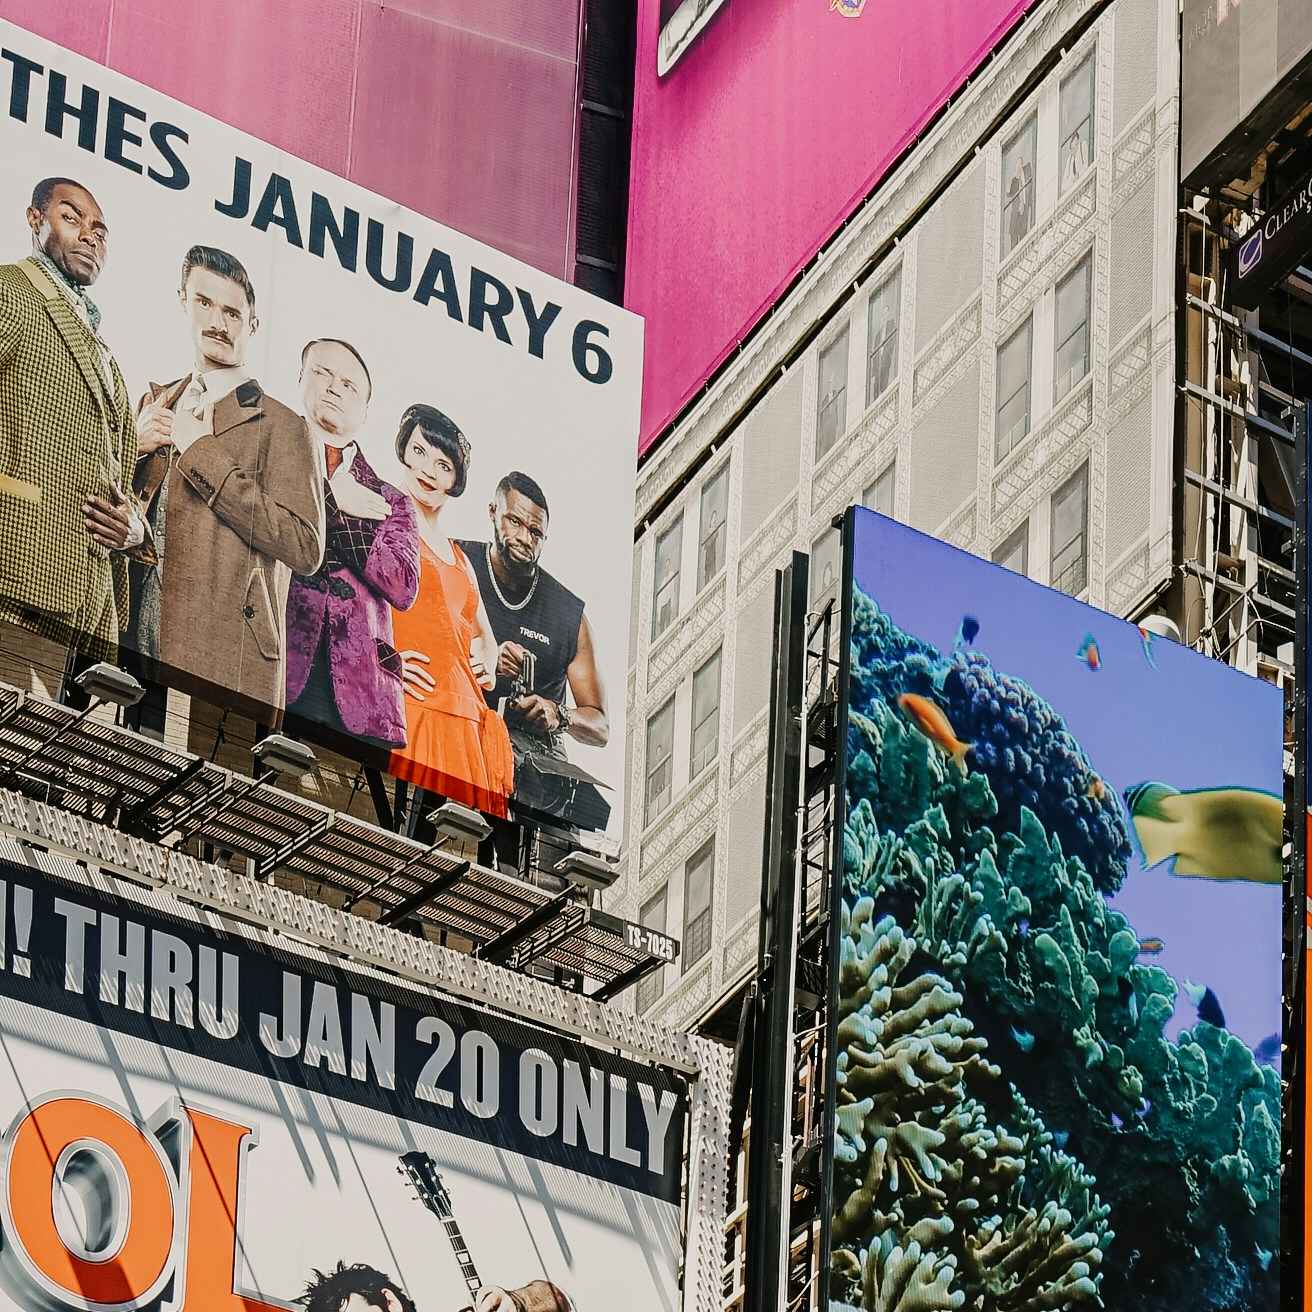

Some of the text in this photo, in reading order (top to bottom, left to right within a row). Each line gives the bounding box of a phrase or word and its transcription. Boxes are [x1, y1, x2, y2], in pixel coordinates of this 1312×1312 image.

[1, 47, 190, 191] THES
[214, 156, 562, 359] JANUARY
[571, 319, 614, 384] 6
[54, 896, 240, 1041] THRU
[259, 970, 396, 1090] JAN
[415, 1016, 500, 1119] 20
[518, 1047, 678, 1176] ONLY
